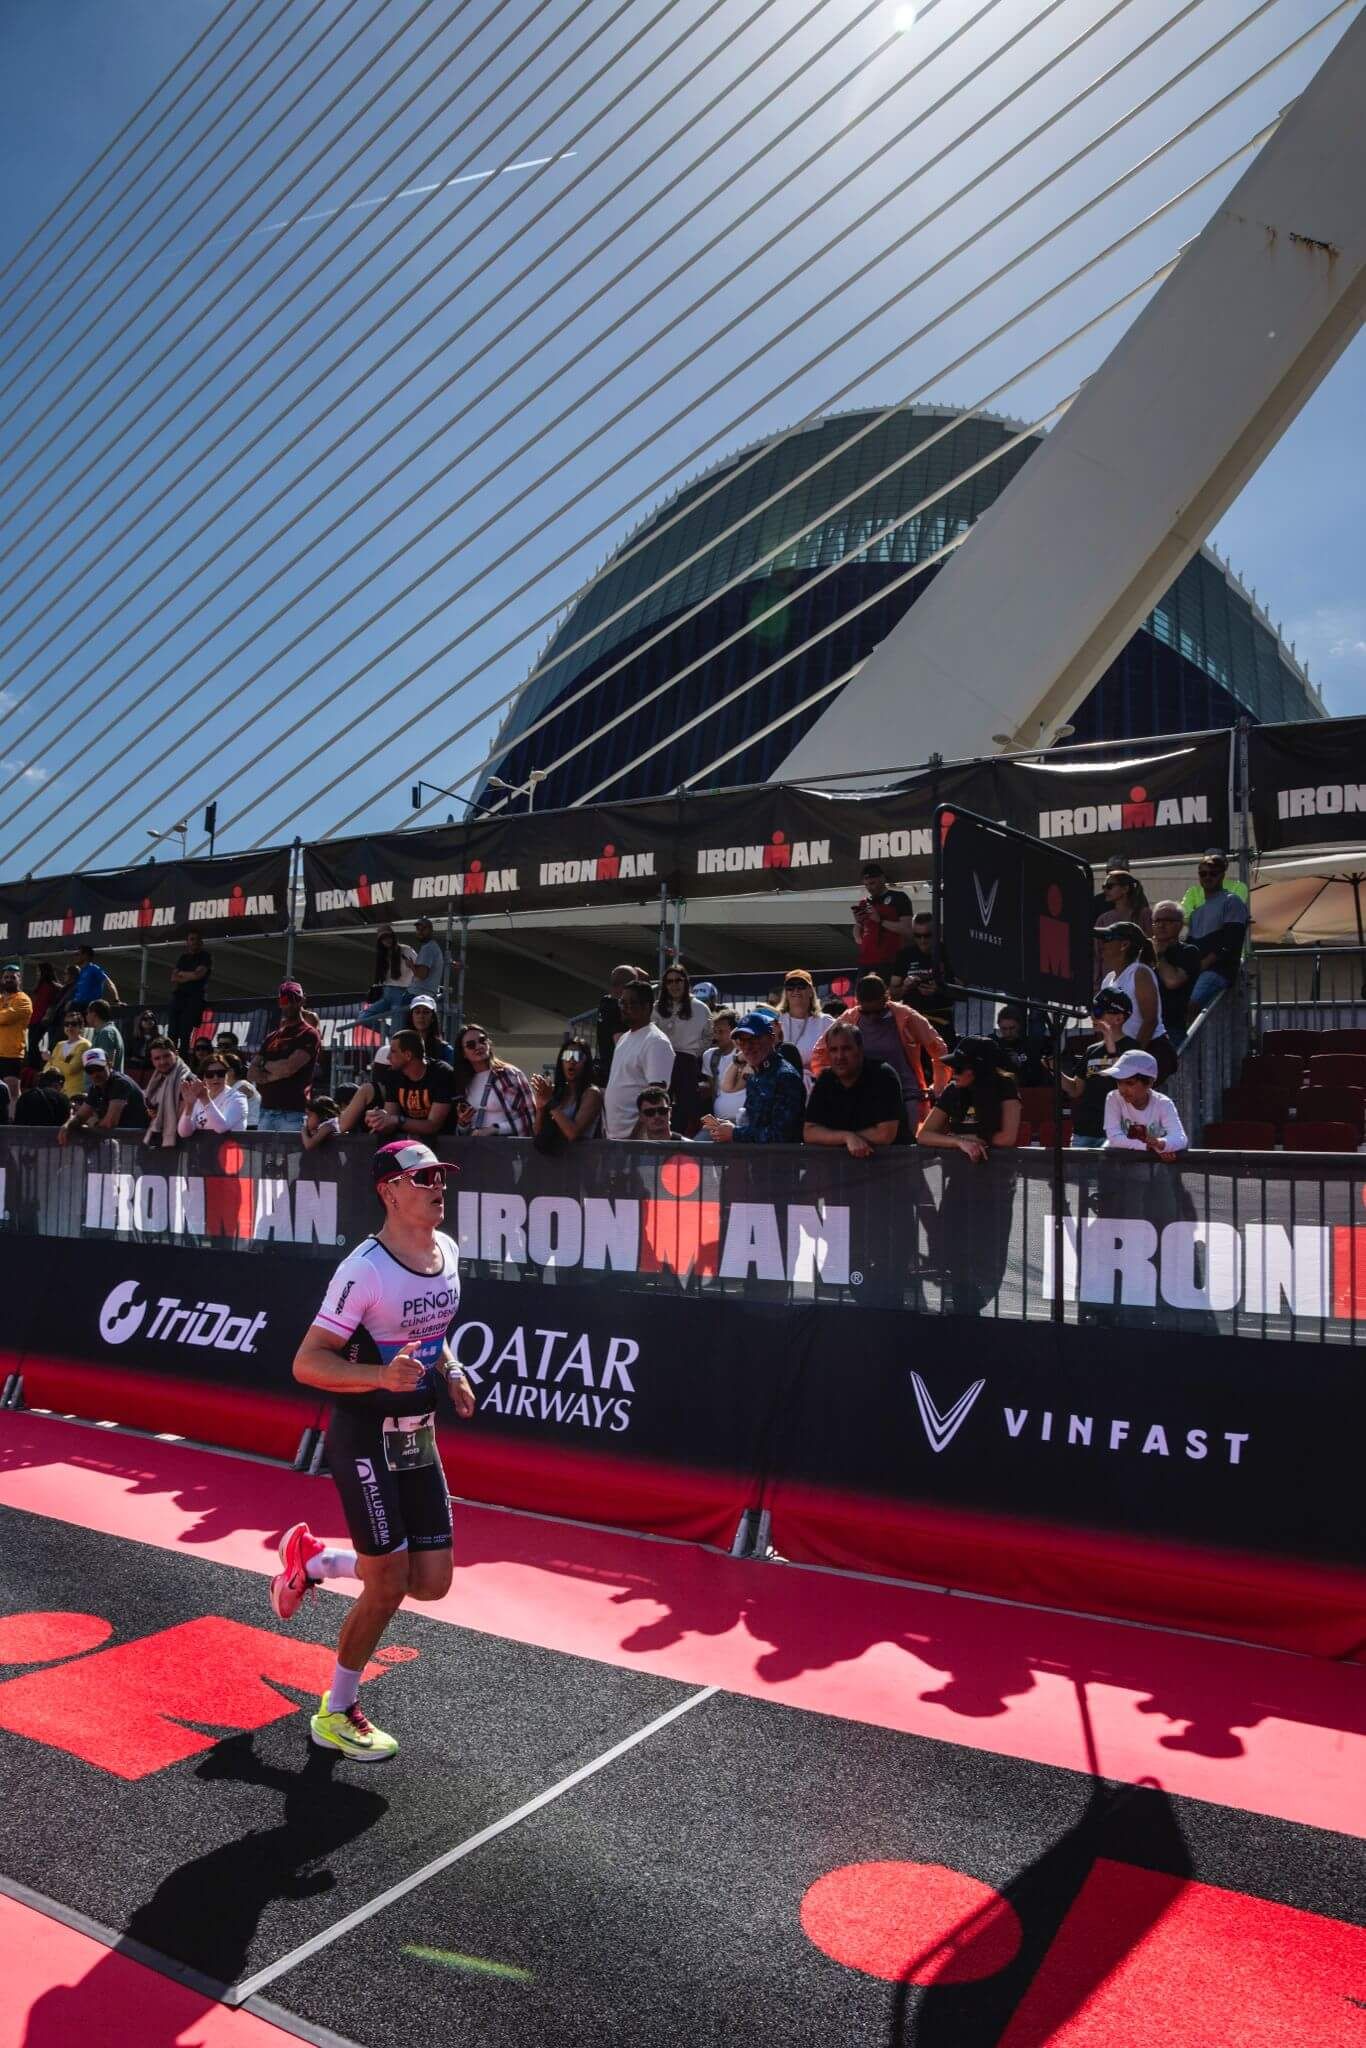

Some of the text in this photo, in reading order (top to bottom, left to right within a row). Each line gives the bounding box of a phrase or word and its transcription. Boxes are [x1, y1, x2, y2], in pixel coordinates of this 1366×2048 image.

[1039, 786, 1209, 838] IRONMAN
[539, 844, 656, 886] IRONMAN
[698, 830, 832, 873] IRONMAN
[188, 884, 275, 921] IRONMAN
[315, 873, 394, 912] IRONMAN
[412, 859, 519, 899] IRONMAN
[27, 908, 92, 939] IRONMAN
[103, 896, 176, 931] IRONMAN
[969, 927, 1003, 946] VINFAST
[85, 1140, 338, 1245] IRONMAN
[457, 1153, 851, 1285] IRONMAN
[145, 1297, 267, 1353] TriDot
[449, 1321, 640, 1393] QATAR
[480, 1381, 632, 1432] AIRWAYS
[1004, 1407, 1249, 1464] VINFAST
[368, 1484, 390, 1545] ALUSIGMA
